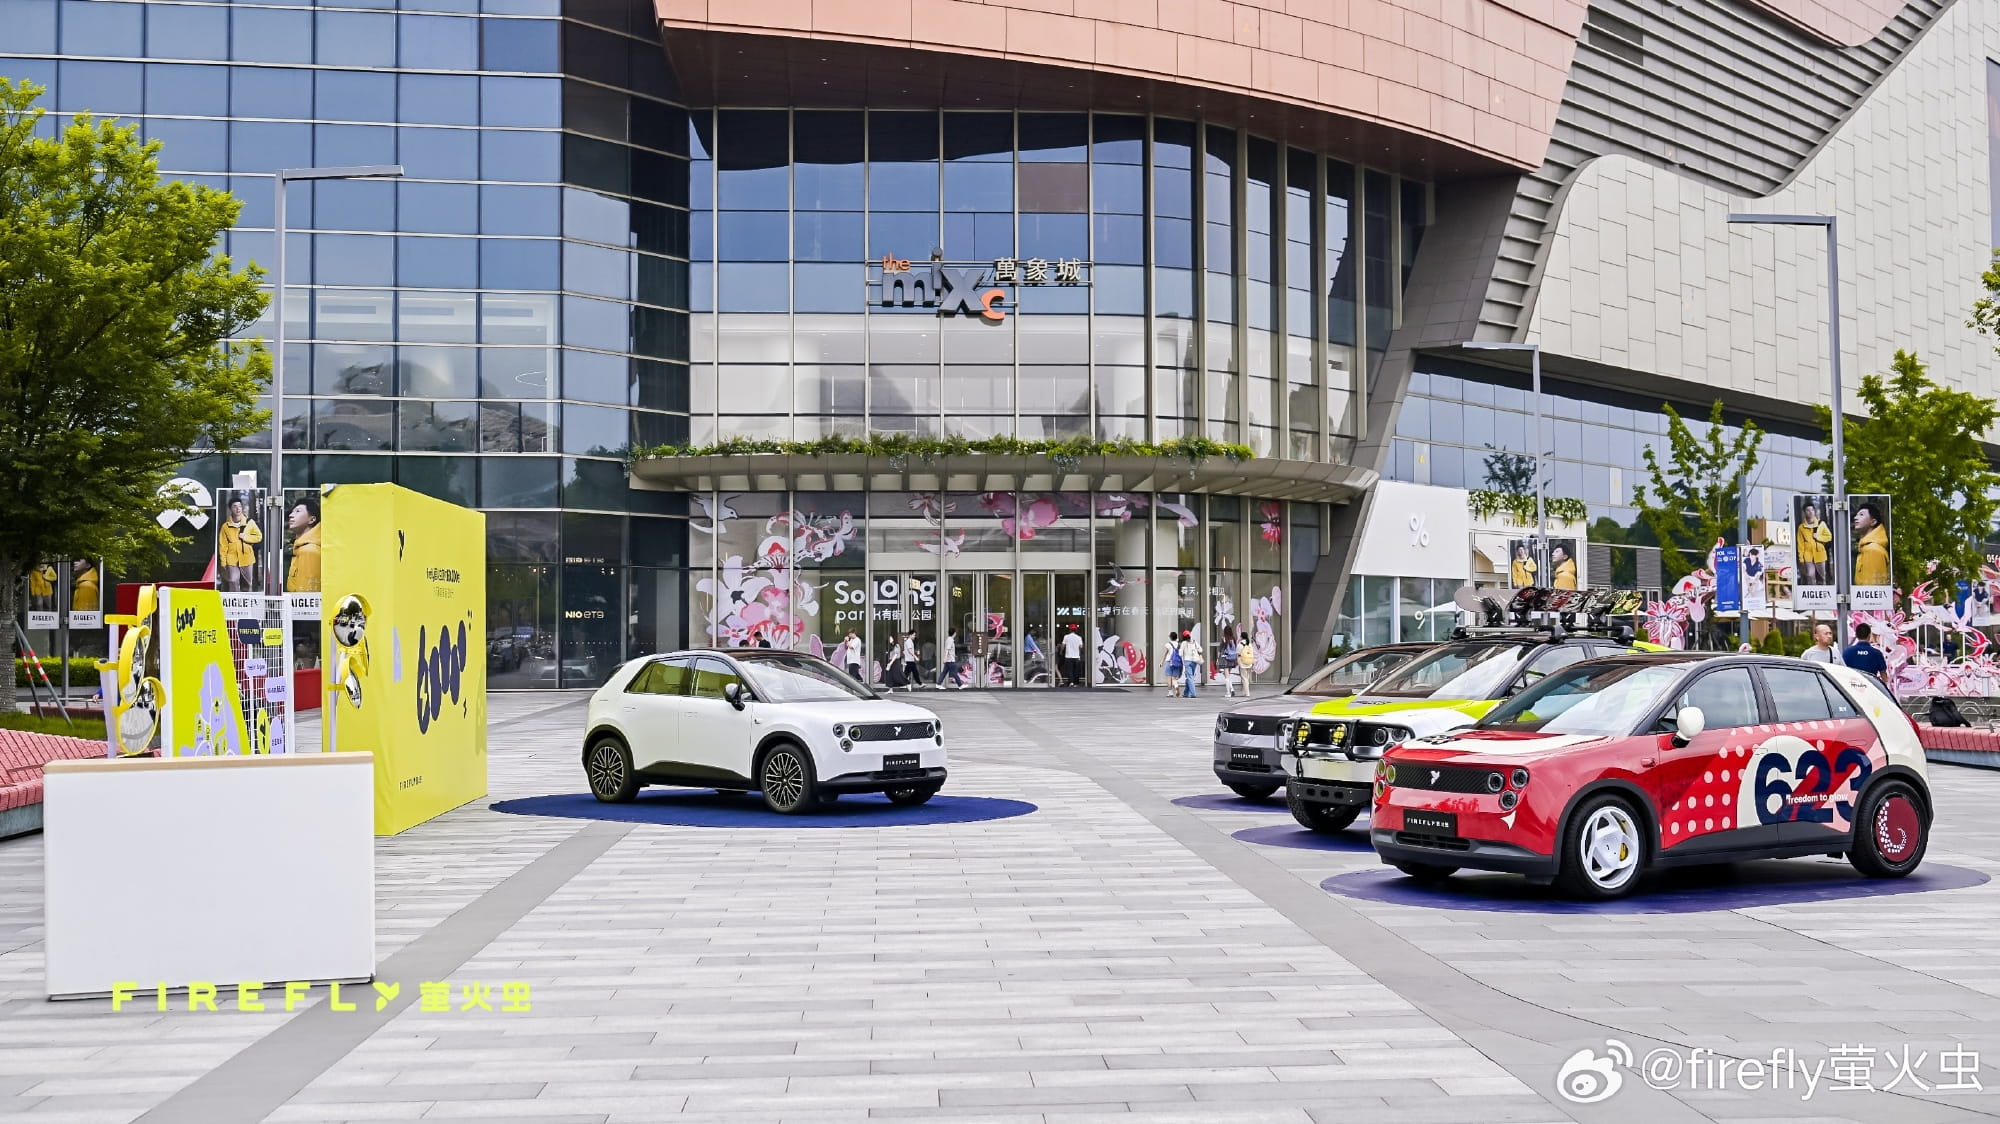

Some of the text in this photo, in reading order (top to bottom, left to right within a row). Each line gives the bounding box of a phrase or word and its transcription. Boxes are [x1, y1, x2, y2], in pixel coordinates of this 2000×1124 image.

[882, 252, 911, 271] the
[993, 257, 1082, 281] 萬象城
[1801, 590, 1823, 599] AIGLE
[1855, 590, 1880, 599] AIGLE
[565, 610, 583, 619] NIO
[1755, 748, 1872, 825] 623
[1819, 792, 1828, 802] to
